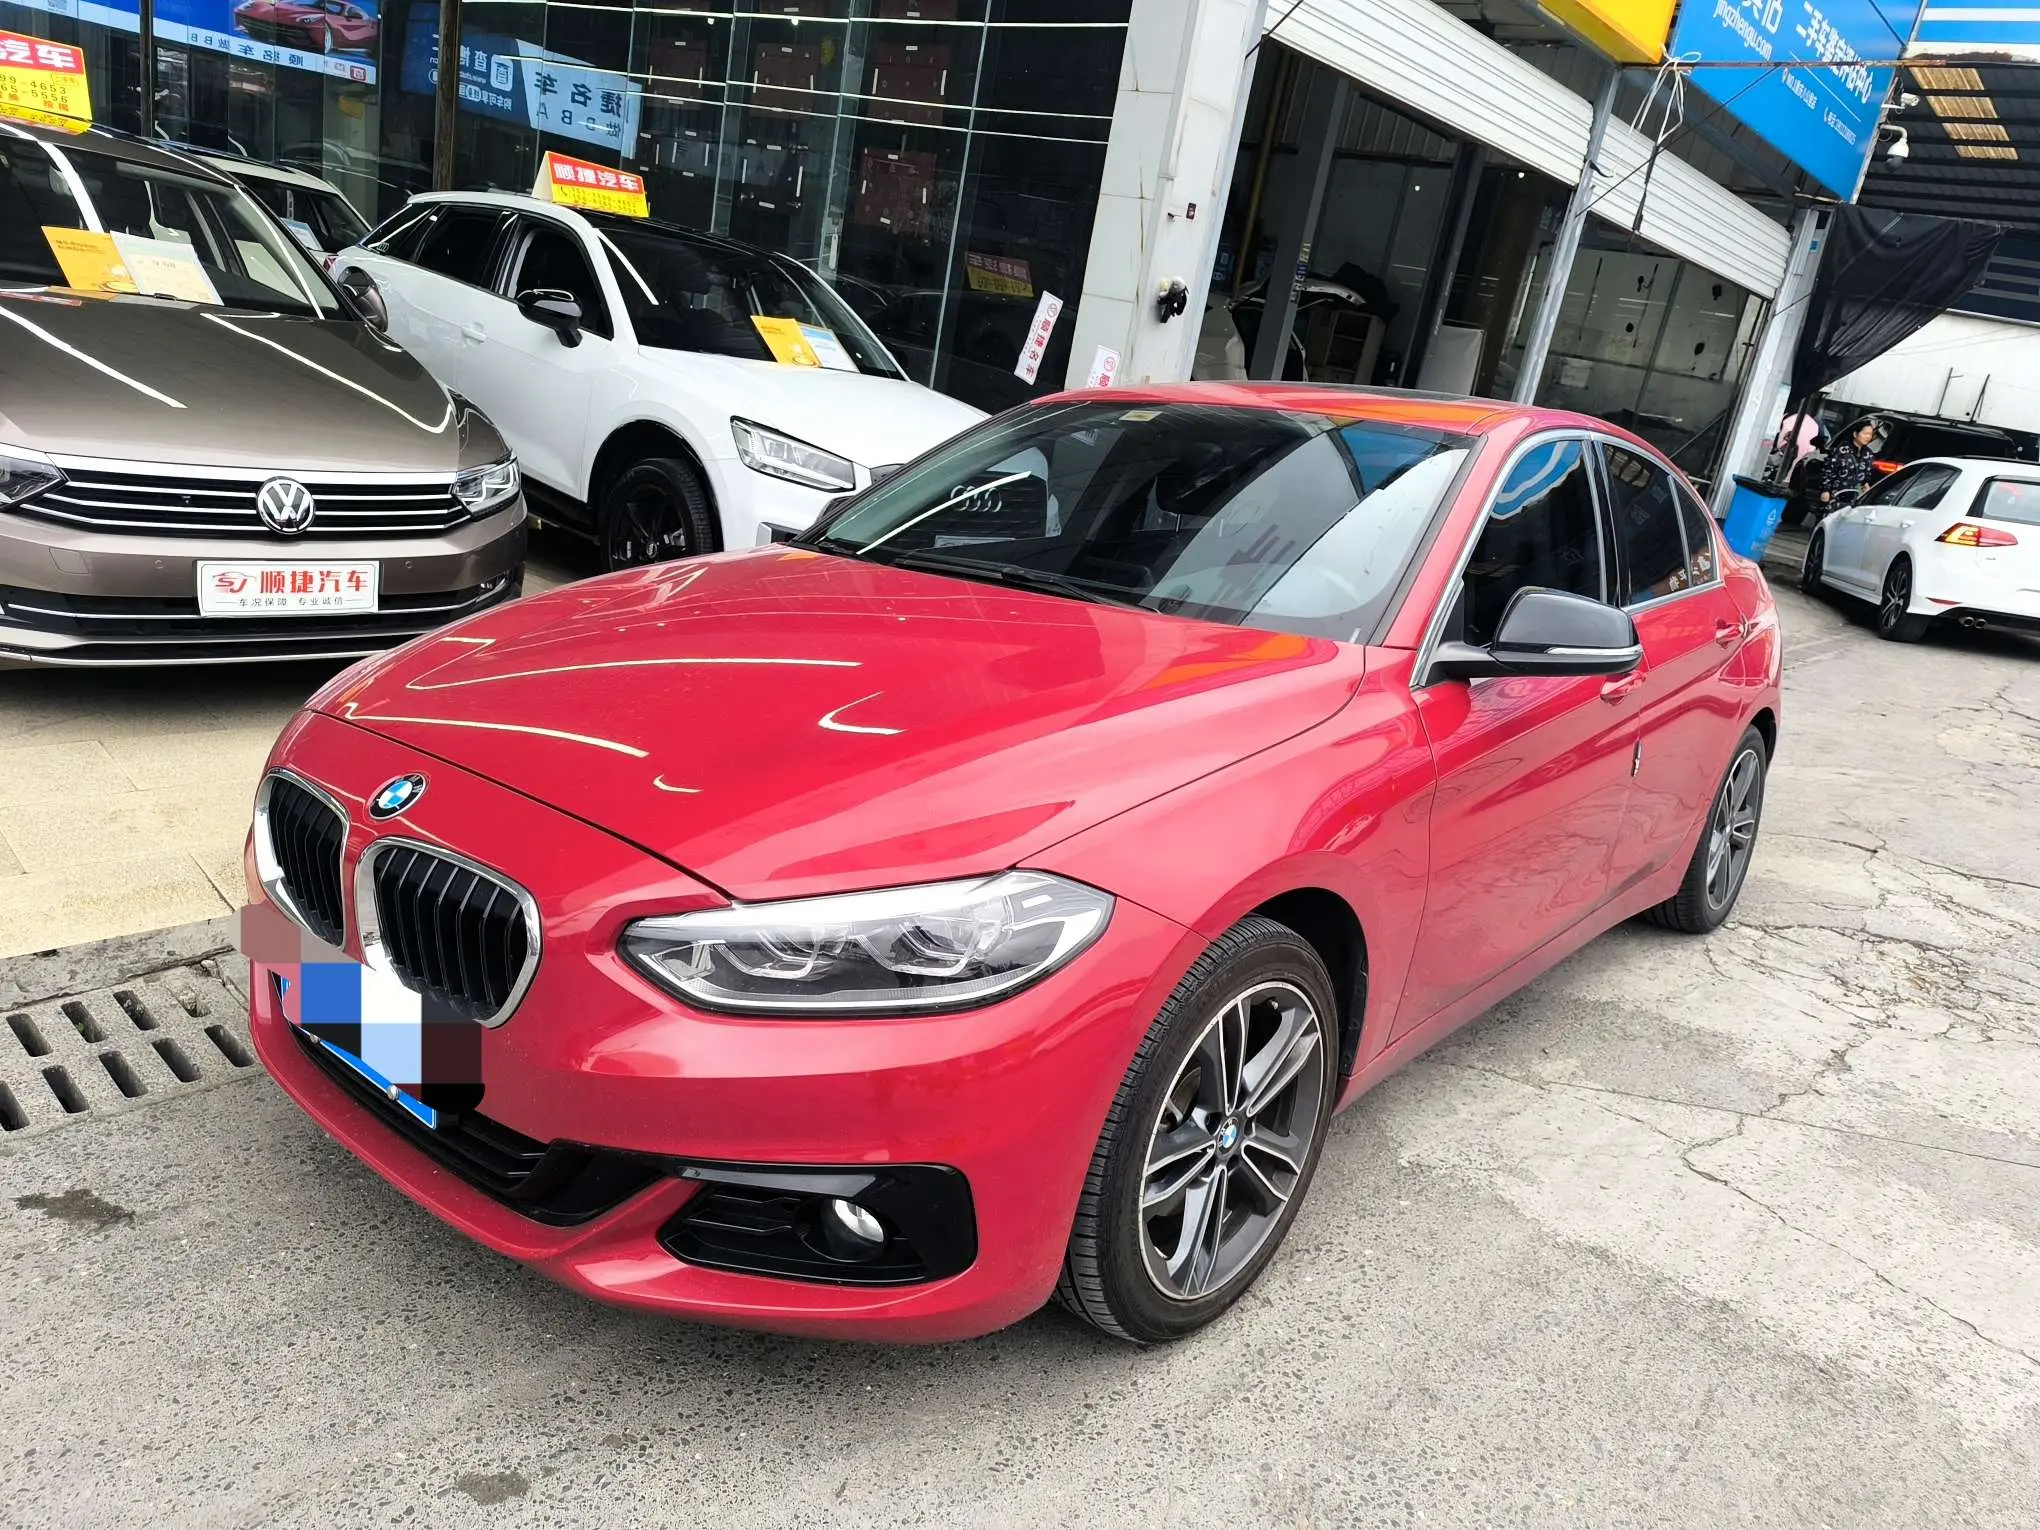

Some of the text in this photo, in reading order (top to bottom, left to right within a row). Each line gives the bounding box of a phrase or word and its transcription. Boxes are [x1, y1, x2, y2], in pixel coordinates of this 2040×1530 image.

[553, 162, 640, 191] 顺捷汽车
[260, 570, 369, 594] 顺捷汽车
